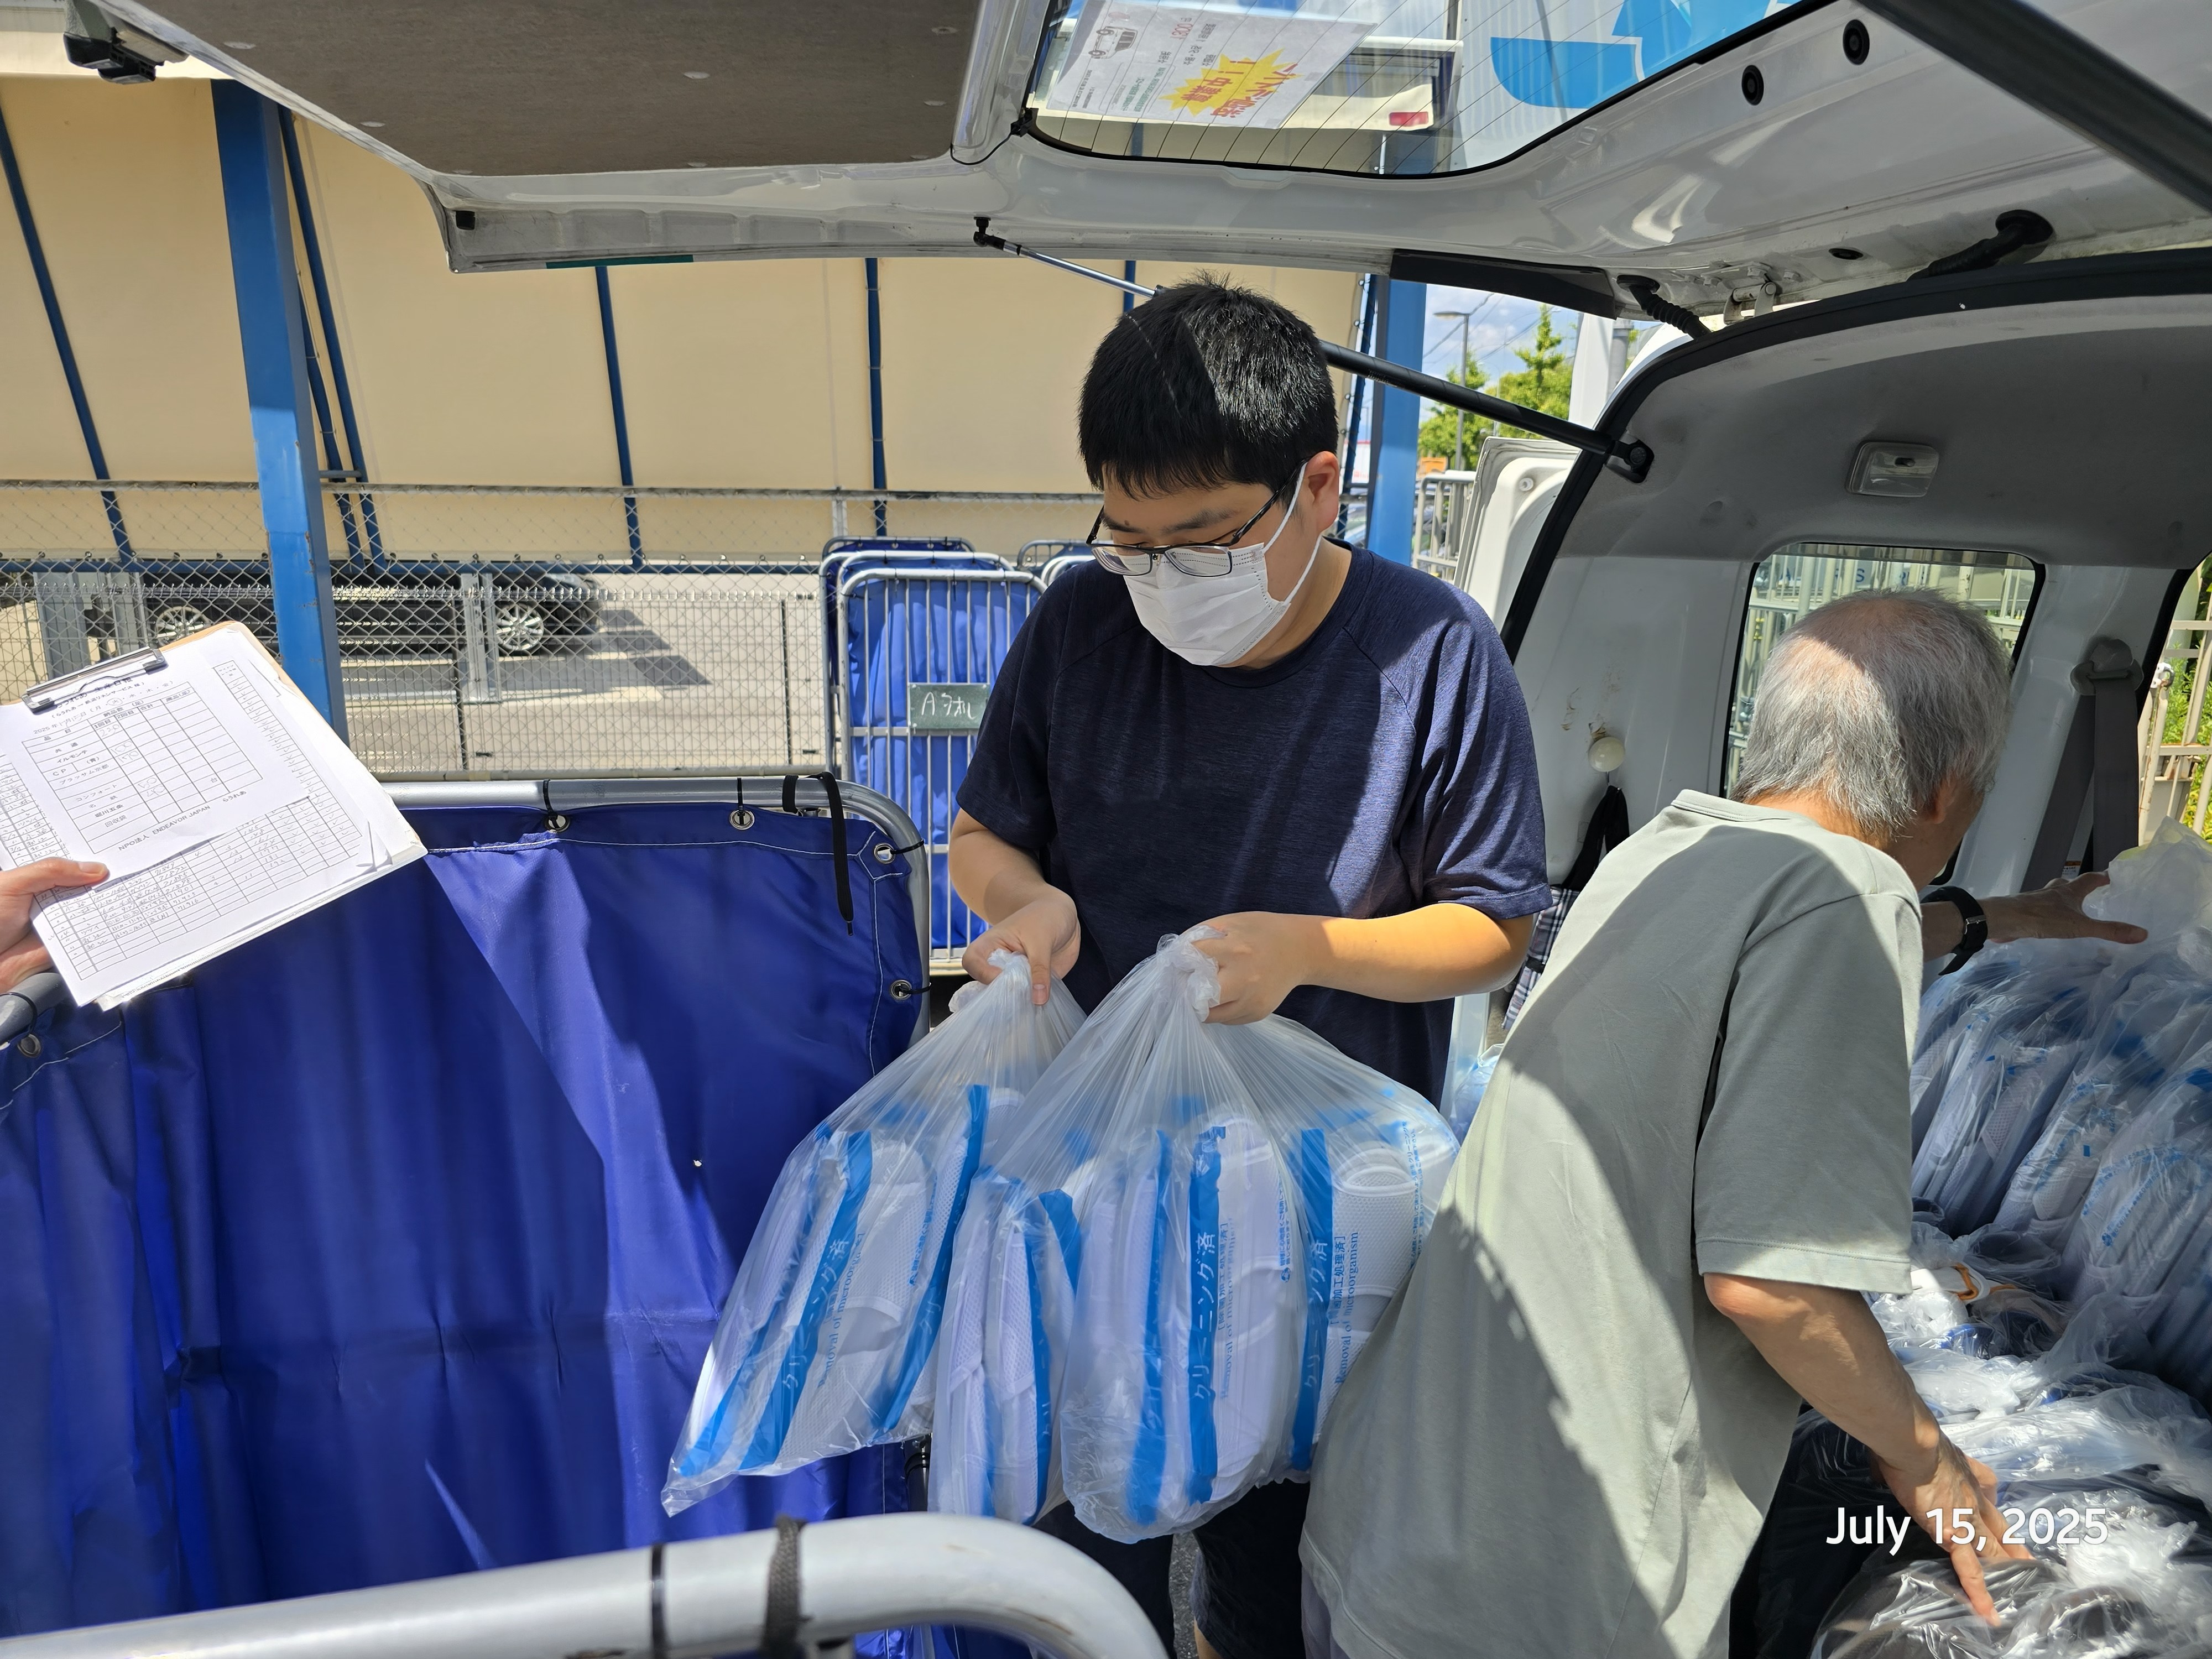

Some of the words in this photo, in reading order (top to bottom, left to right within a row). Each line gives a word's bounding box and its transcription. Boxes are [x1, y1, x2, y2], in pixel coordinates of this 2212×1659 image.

[118, 834, 149, 851] NPO法人
[152, 815, 188, 834] ENDEAVOR
[189, 805, 211, 818] JAPAN
[1191, 1231, 1216, 1400] クリーニング済
[1334, 1335, 1352, 1384] Removal
[1343, 1232, 1358, 1316] microorganism
